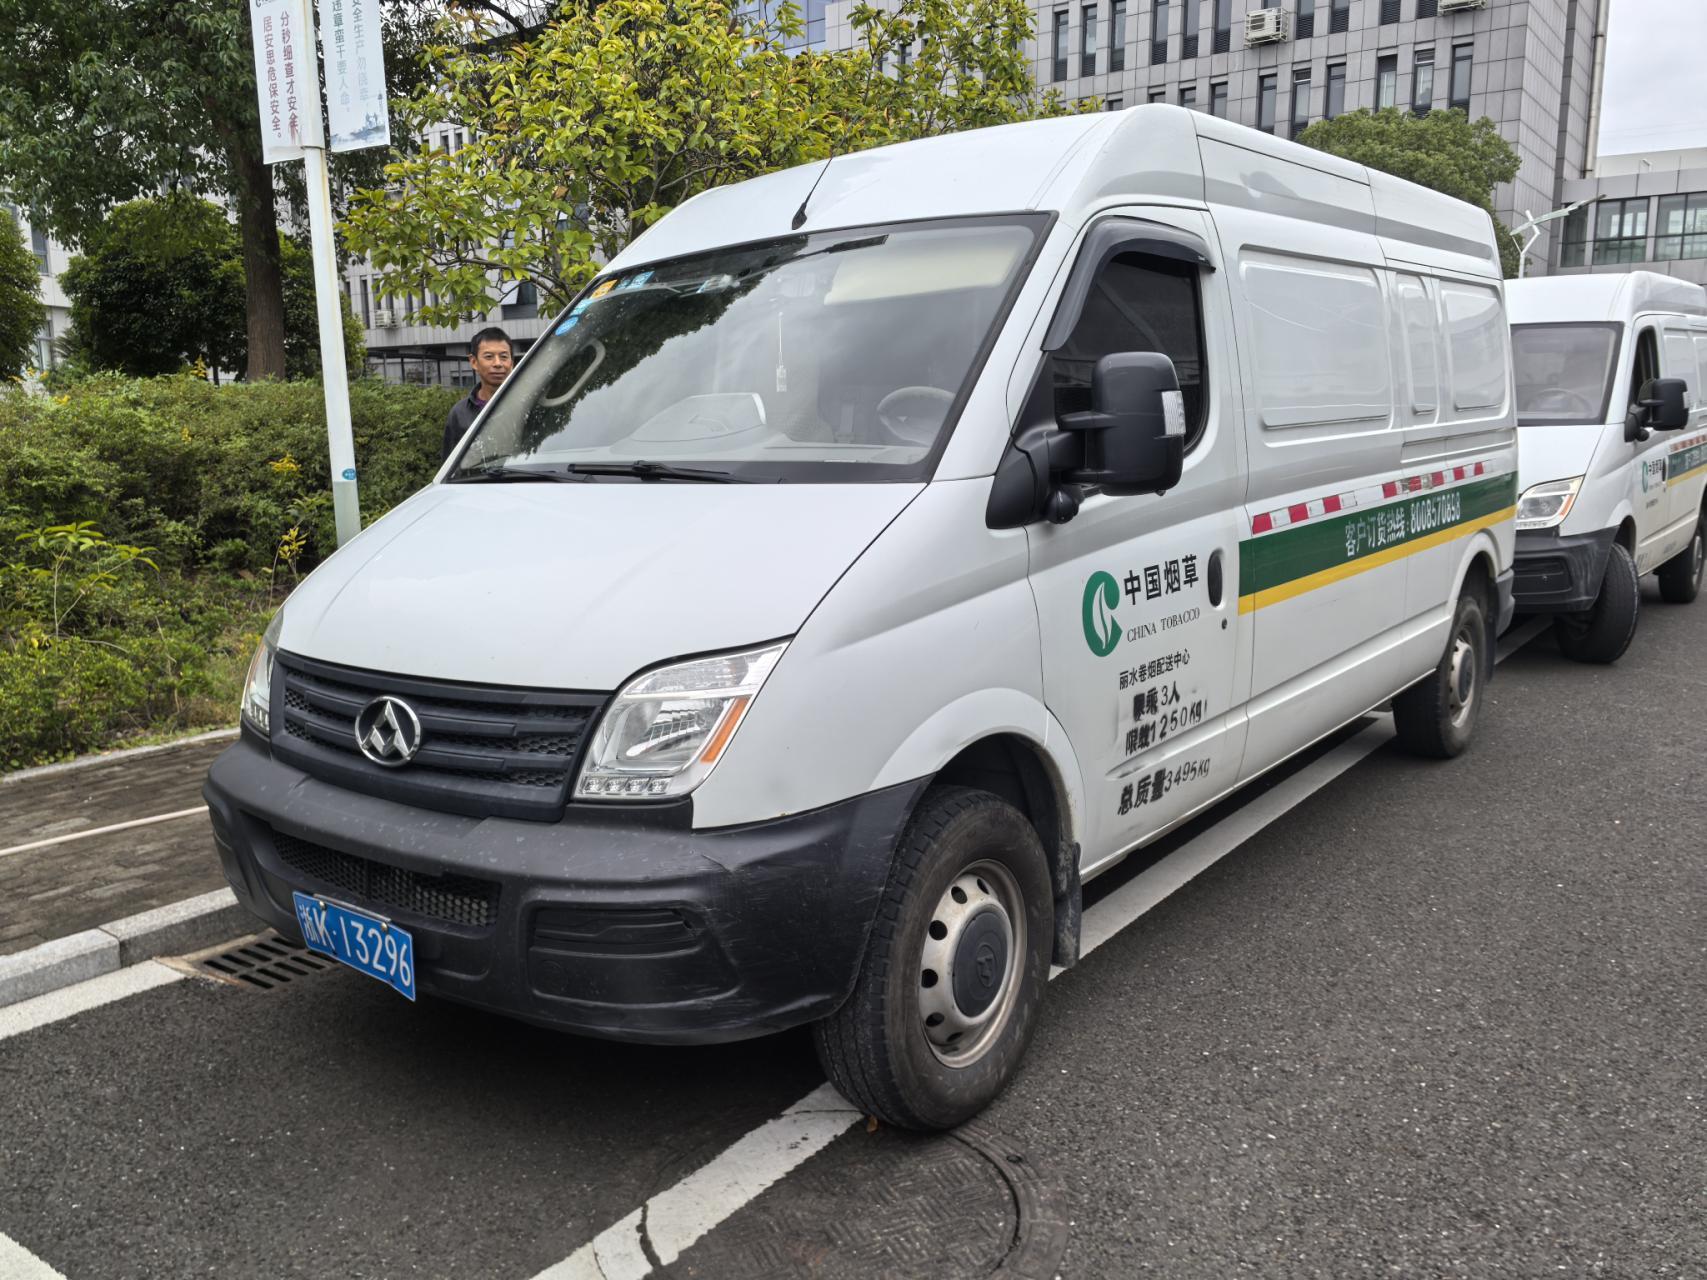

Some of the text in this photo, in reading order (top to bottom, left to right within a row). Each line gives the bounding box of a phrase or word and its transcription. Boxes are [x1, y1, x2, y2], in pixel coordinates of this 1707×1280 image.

[1123, 553, 1199, 606] 中国烟草
[1126, 607, 1201, 643] CHINA TOBACCO
[1119, 648, 1190, 690] 丽水卷烟配送中心
